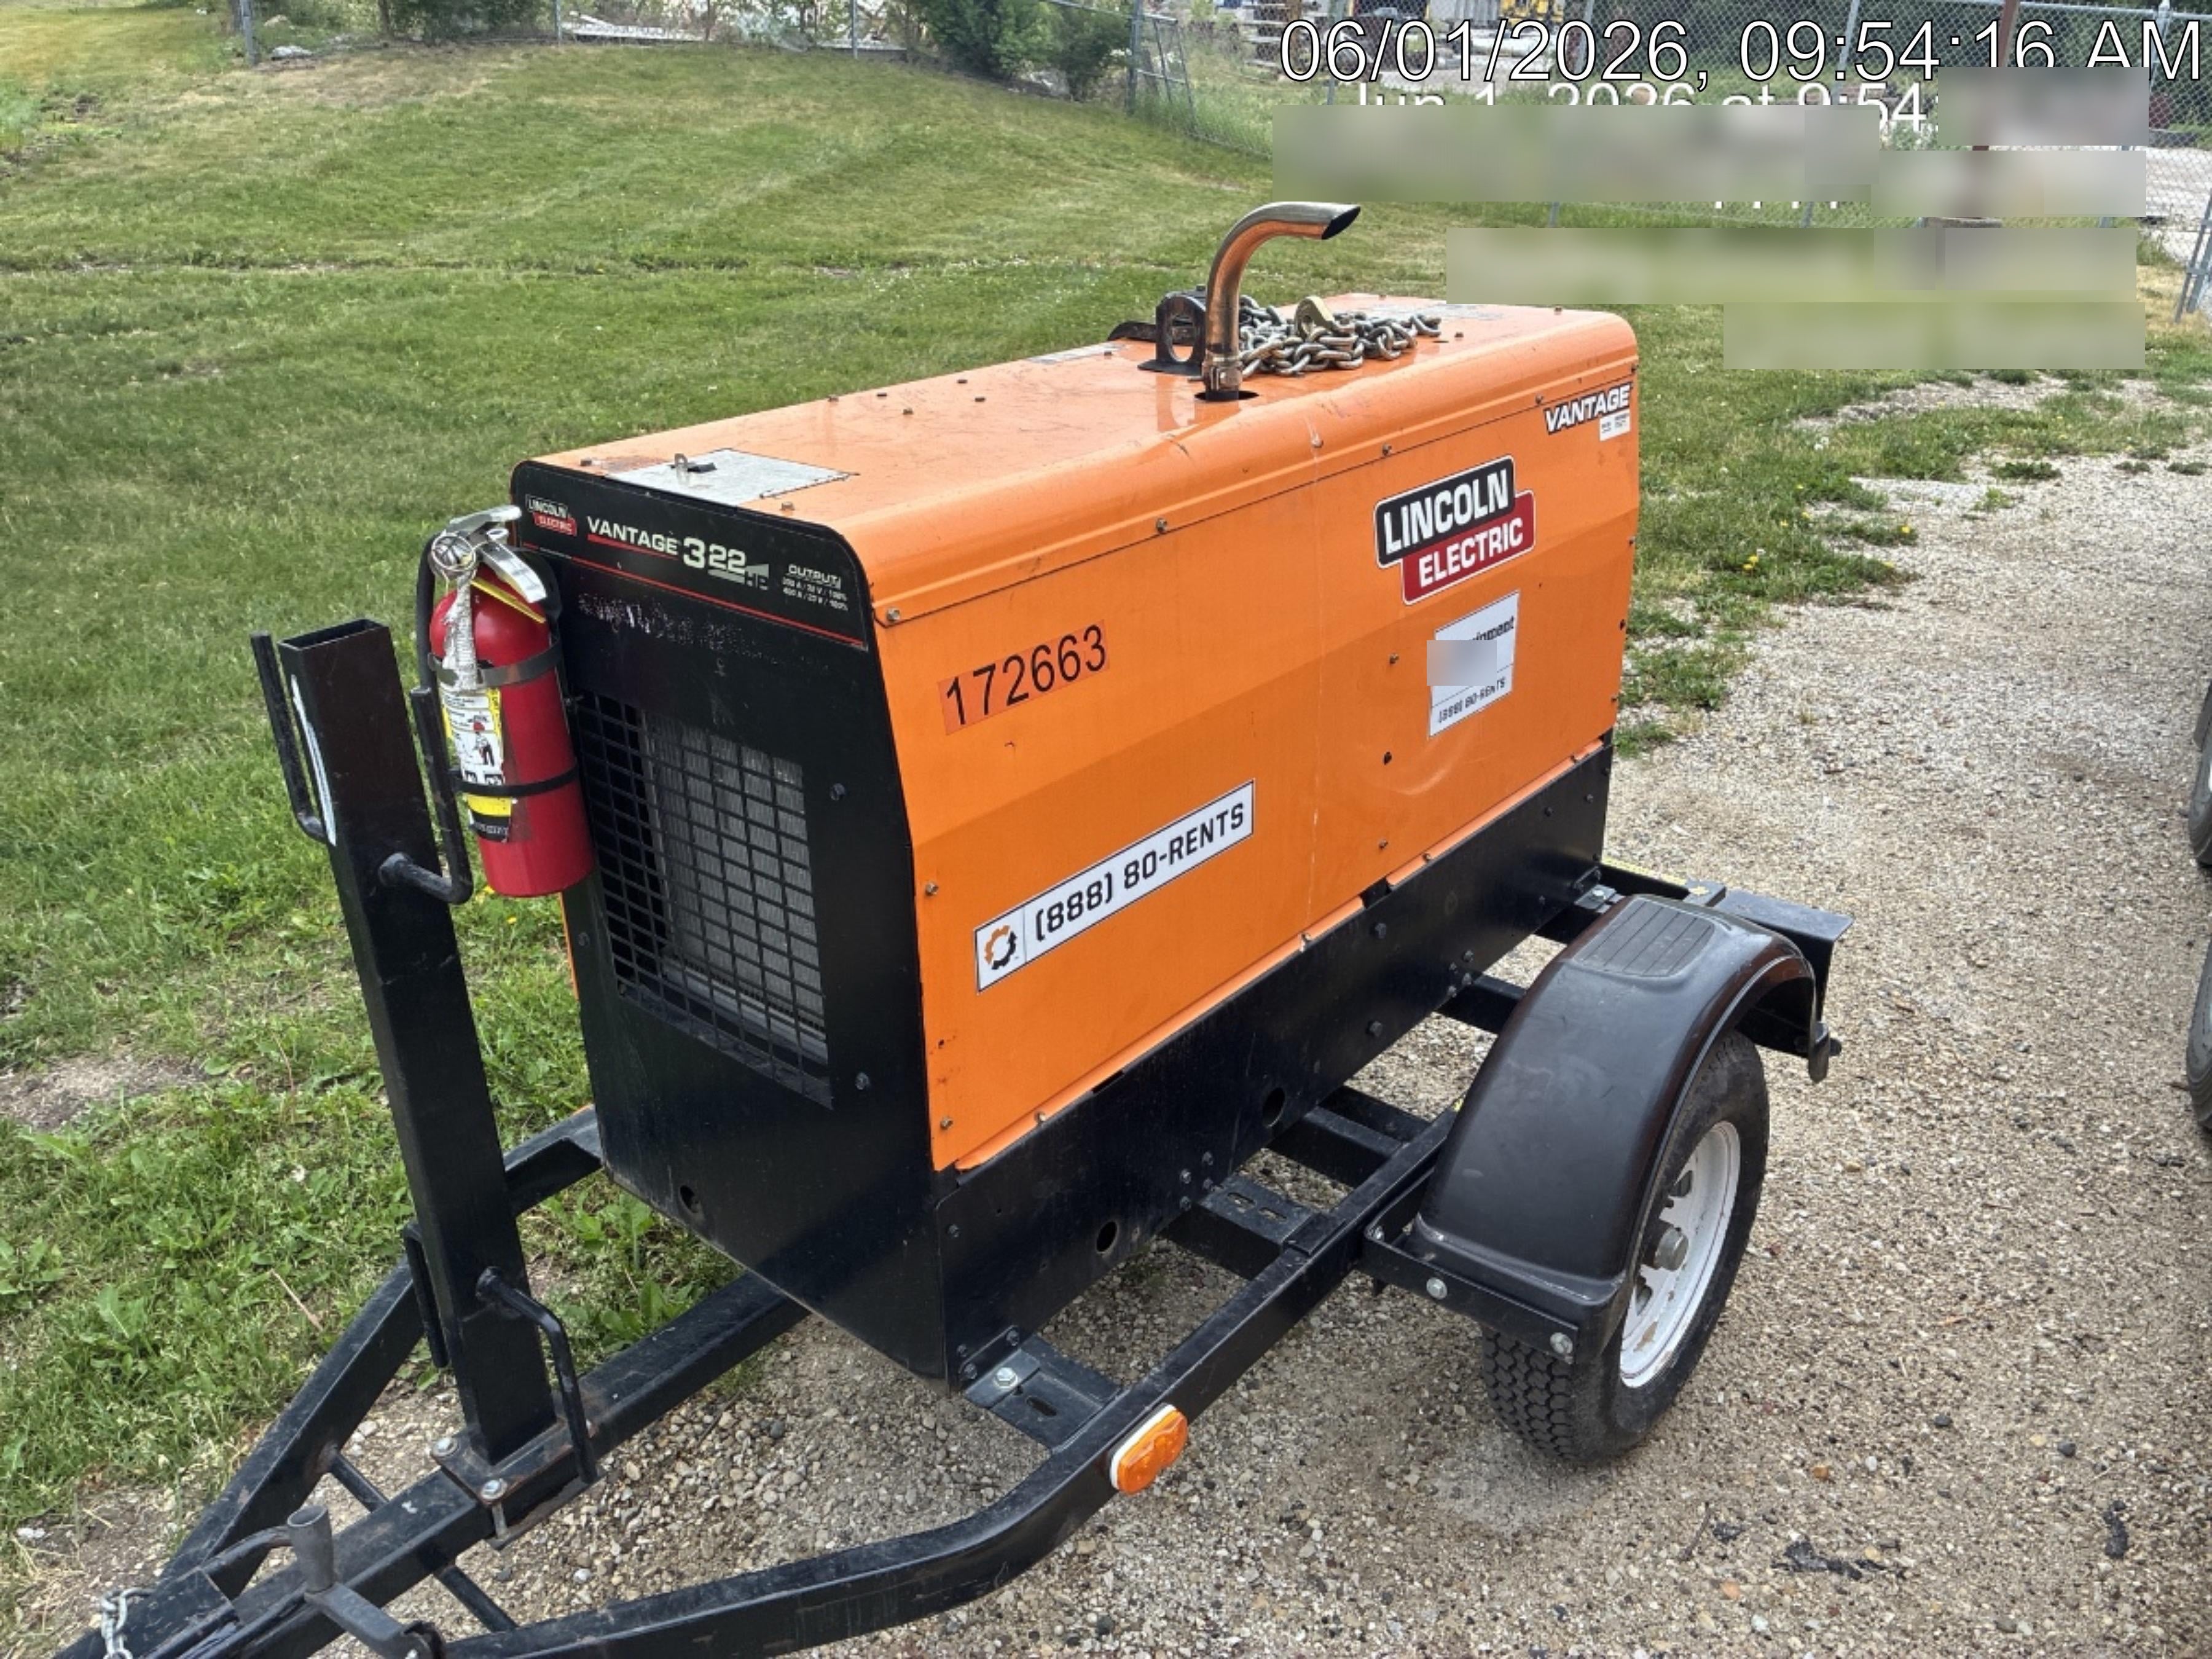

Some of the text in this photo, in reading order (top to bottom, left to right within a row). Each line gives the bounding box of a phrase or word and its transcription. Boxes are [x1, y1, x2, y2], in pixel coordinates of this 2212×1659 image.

[1545, 383, 1631, 434] VANTAGE
[587, 516, 678, 556] VANTAGE
[683, 536, 747, 575] 322
[1383, 468, 1510, 555] LINCOLN
[1418, 517, 1524, 588] ELECTRIC
[946, 624, 1106, 725] 172663
[1035, 802, 1244, 941] (888) 80-RENTS
